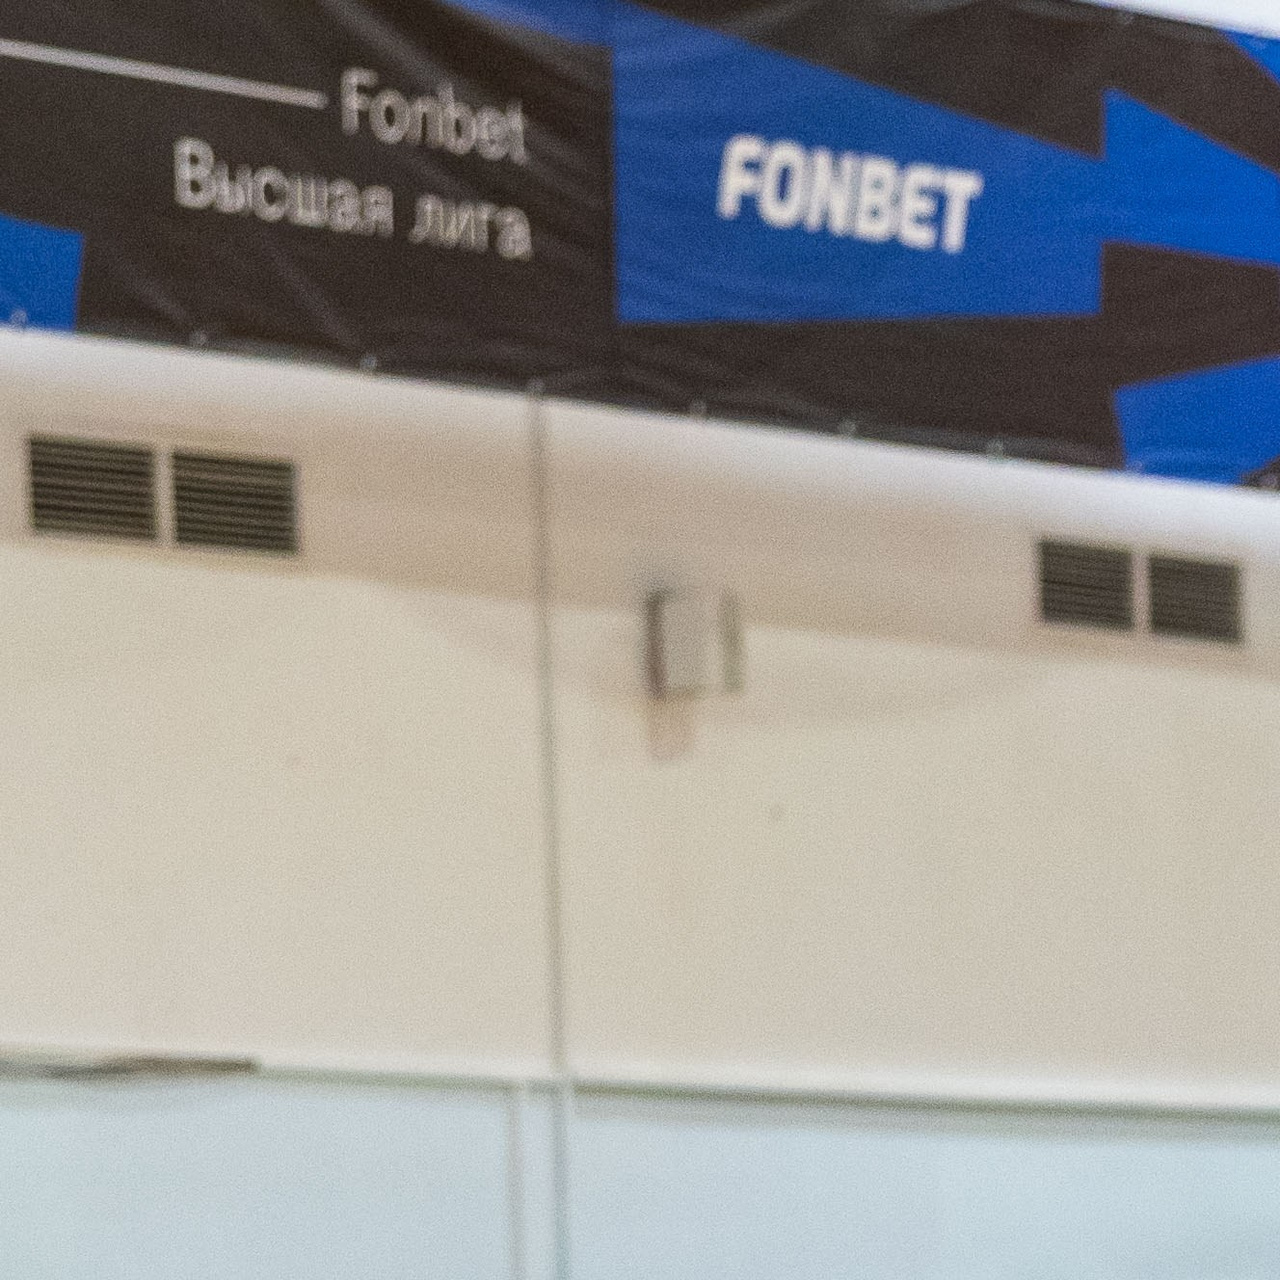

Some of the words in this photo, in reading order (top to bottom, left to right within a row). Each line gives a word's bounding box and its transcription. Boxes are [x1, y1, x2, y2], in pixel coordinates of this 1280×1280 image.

[339, 66, 527, 167] Fonbet
[173, 136, 394, 239] Высшая
[408, 193, 533, 262] лига
[718, 133, 984, 255] FONBET
